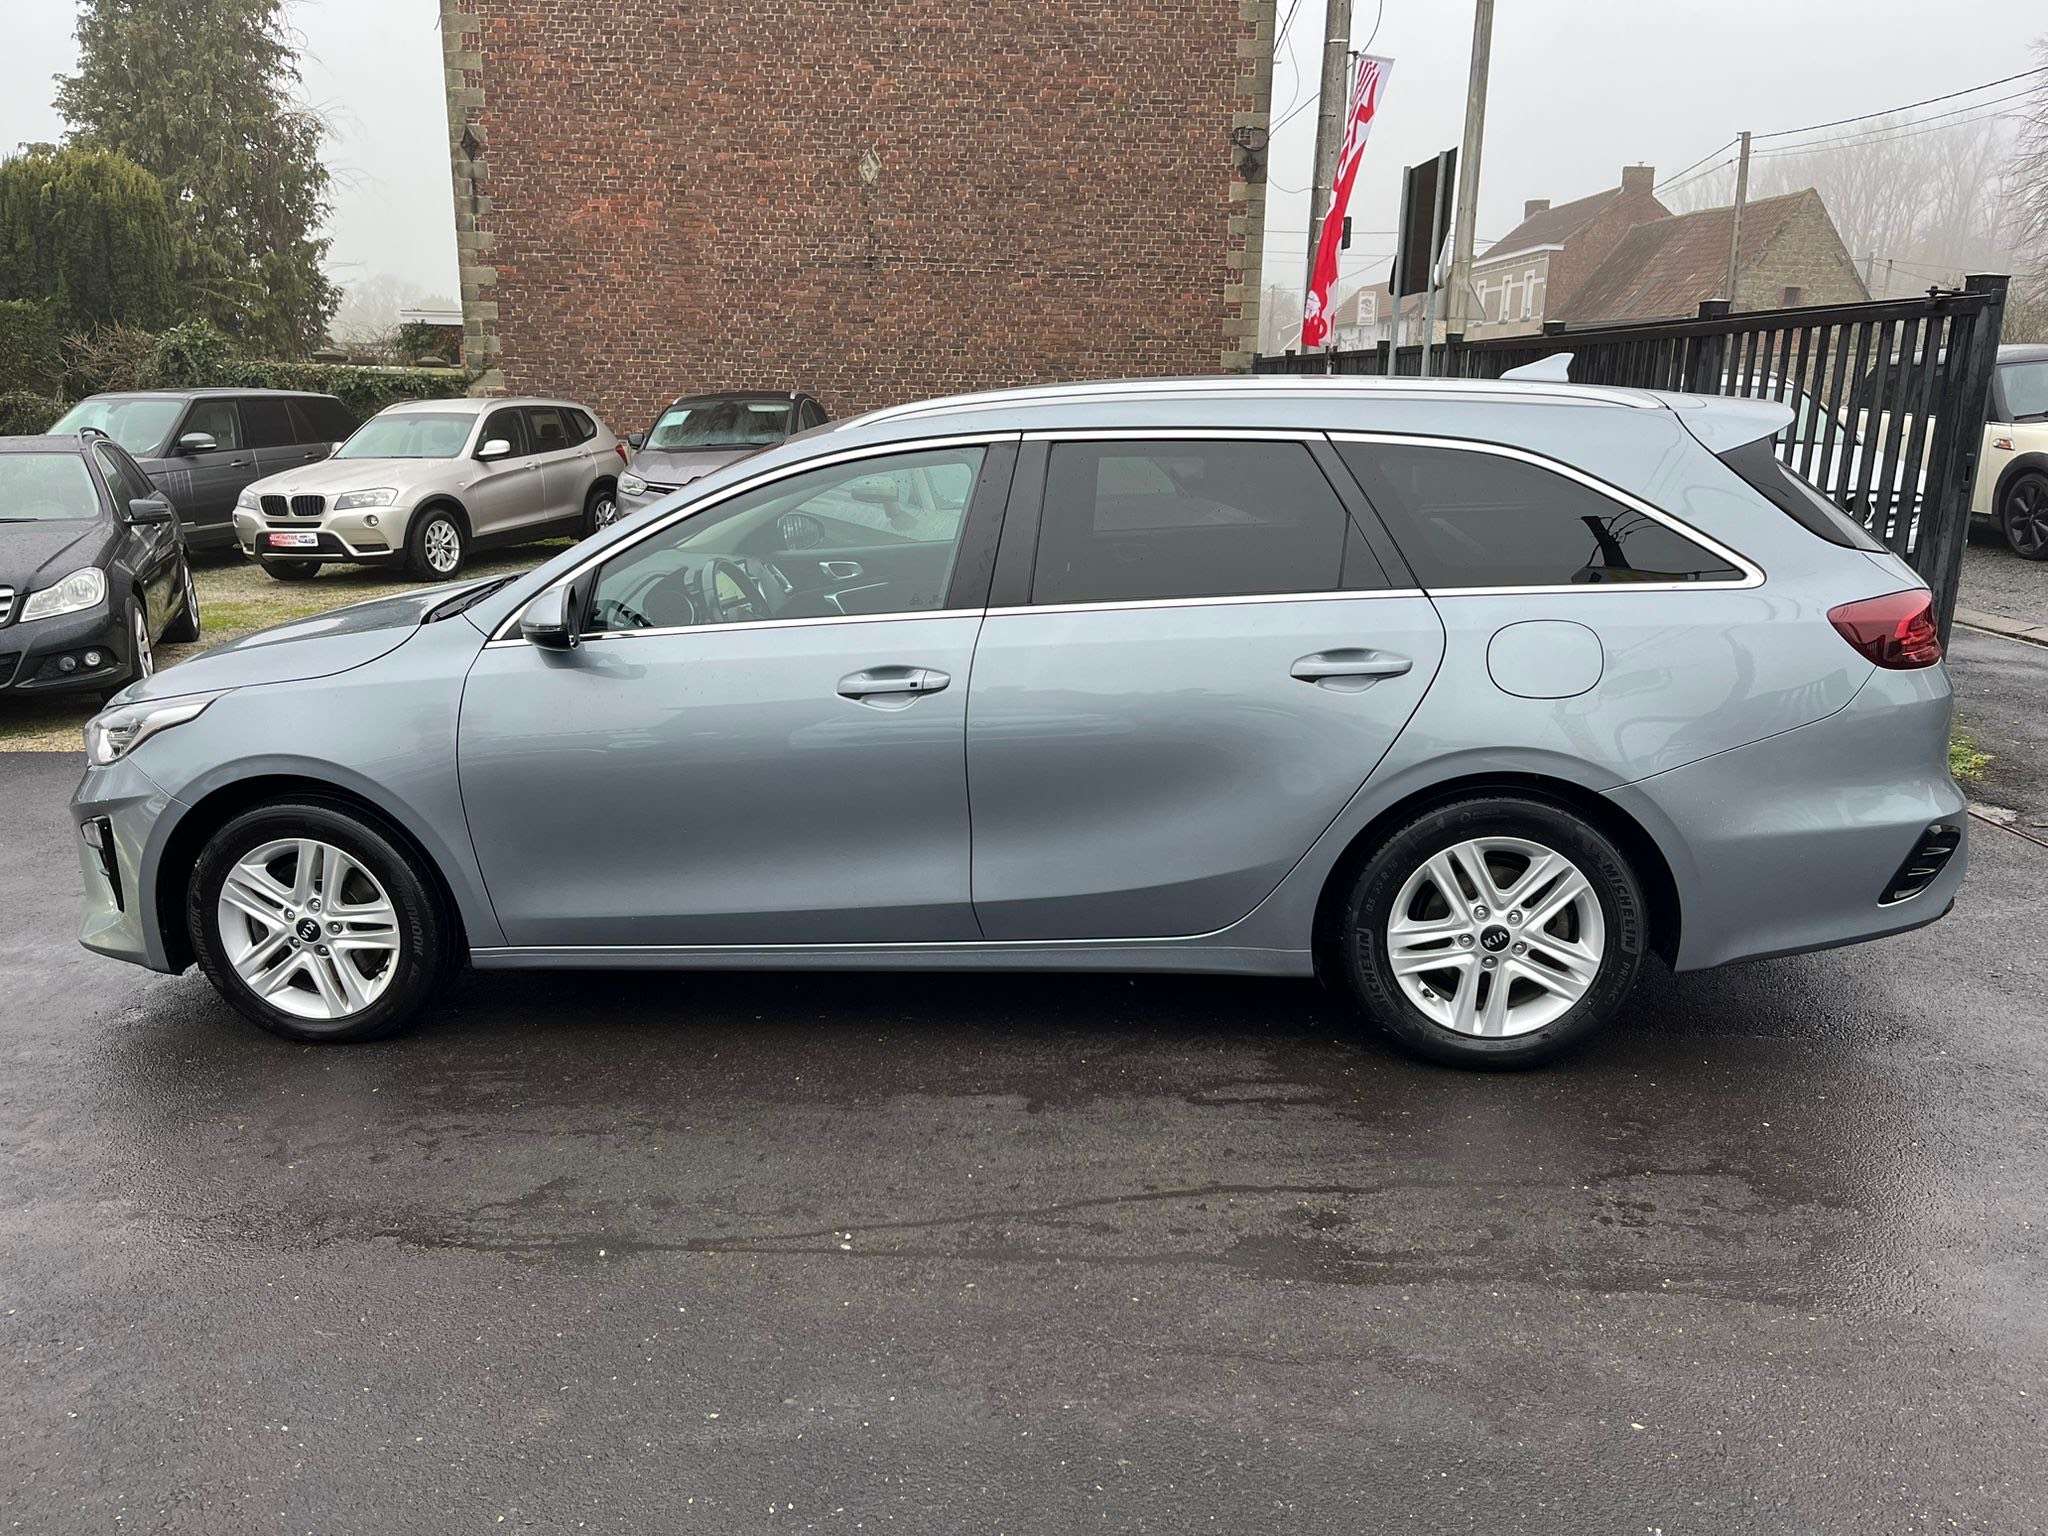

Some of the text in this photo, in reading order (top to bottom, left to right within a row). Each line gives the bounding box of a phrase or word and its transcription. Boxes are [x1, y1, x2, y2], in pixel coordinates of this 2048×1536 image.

[1602, 863, 1637, 949] MICHELIN
[300, 921, 316, 940] KIA
[1483, 931, 1508, 948] KIA
